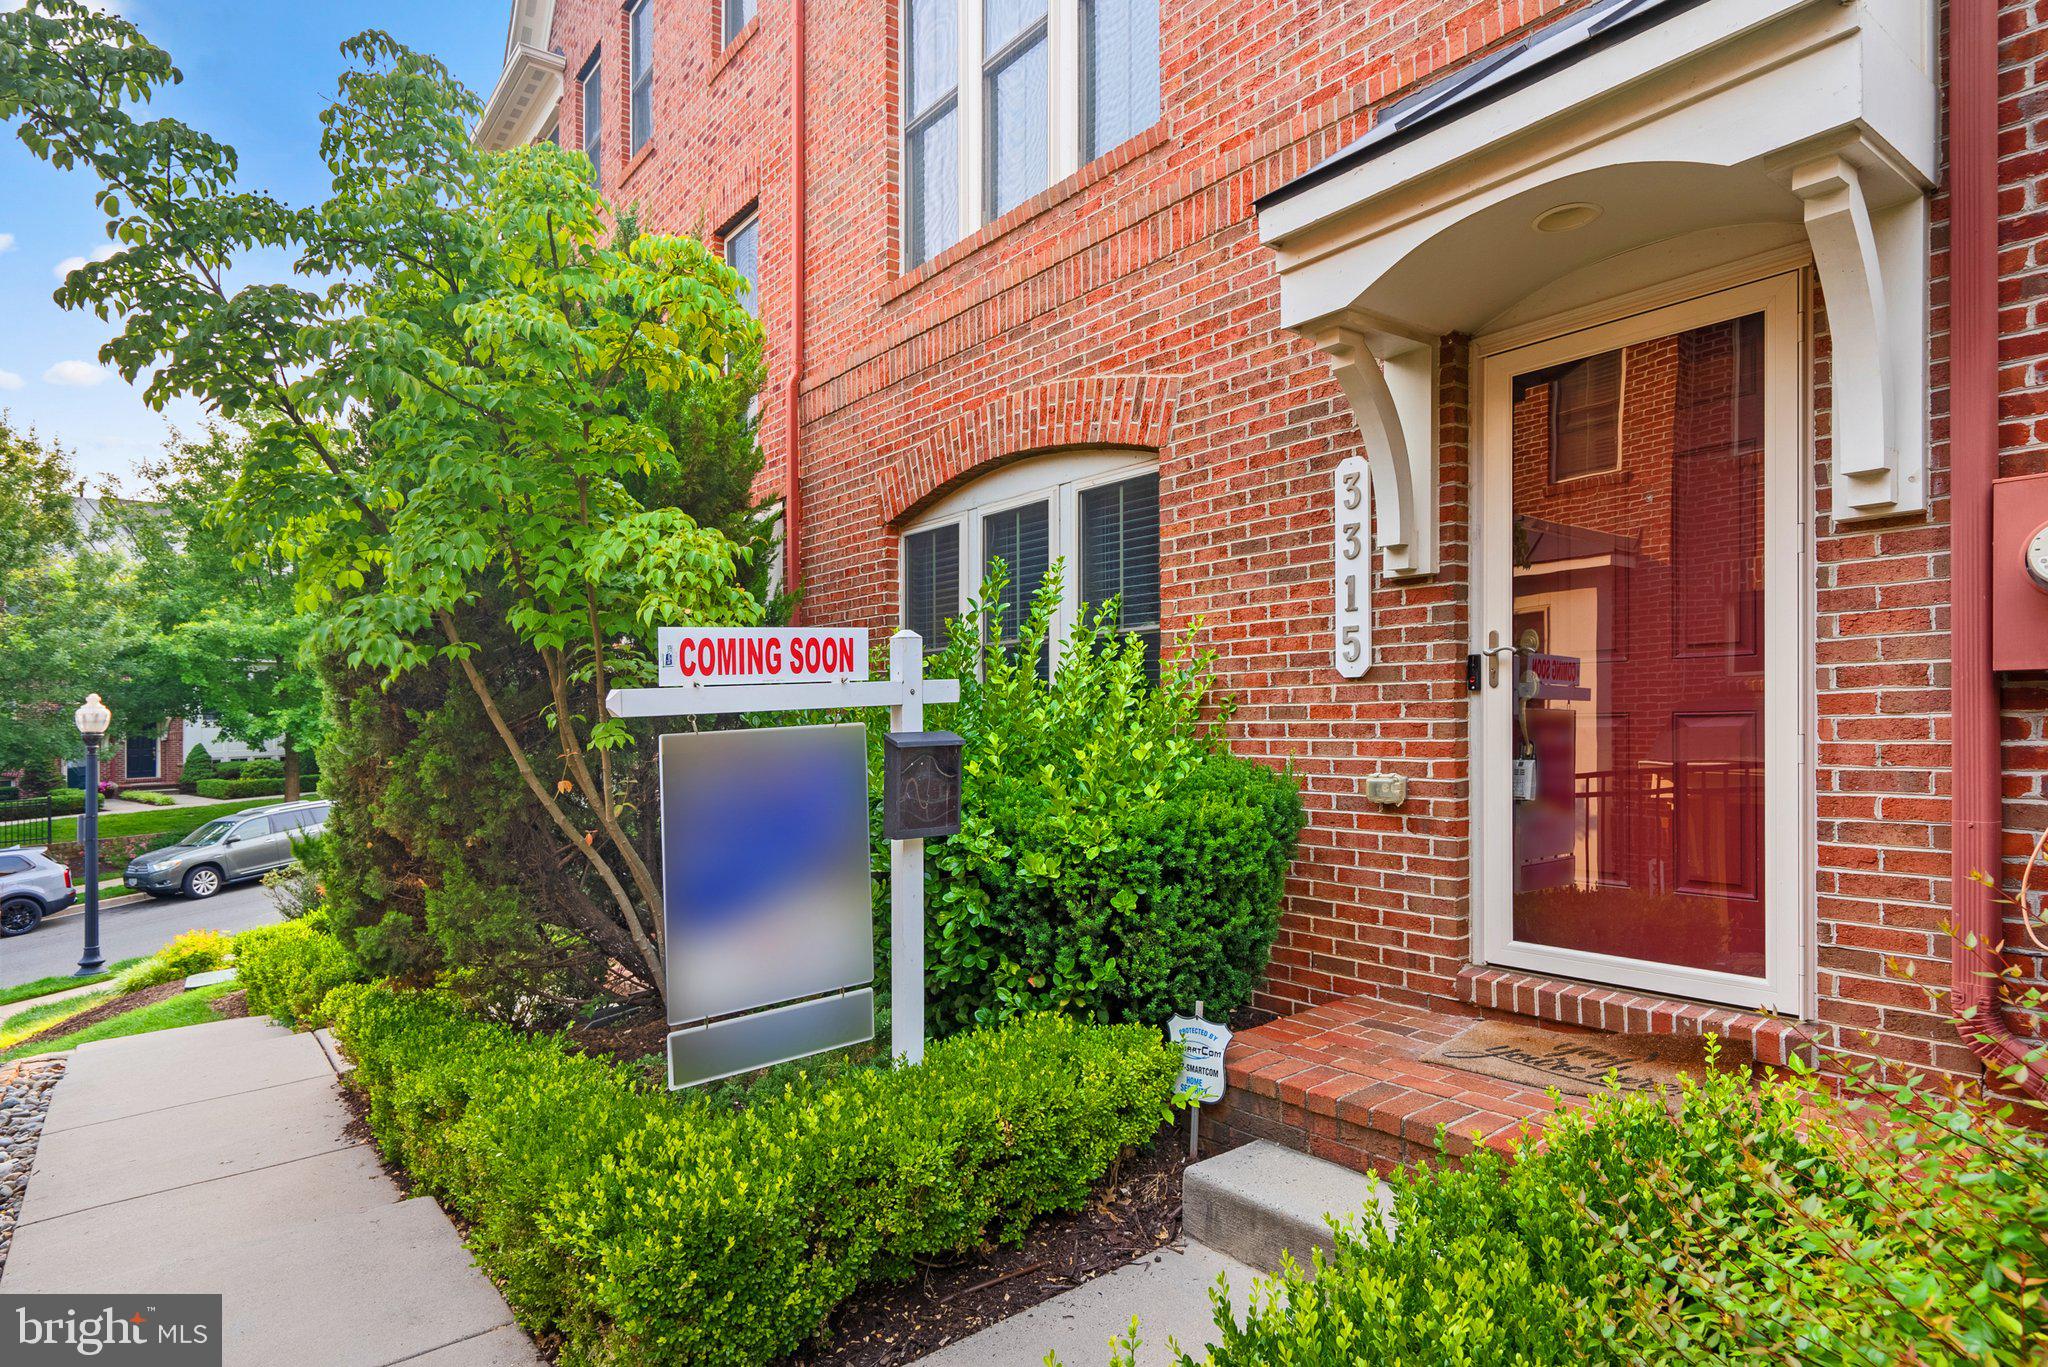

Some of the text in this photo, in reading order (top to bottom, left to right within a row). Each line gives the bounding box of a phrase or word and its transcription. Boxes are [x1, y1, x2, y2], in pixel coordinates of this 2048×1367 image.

[1342, 471, 1362, 663] 3315
[679, 637, 782, 677] COMING
[789, 637, 854, 674] SOON
[1179, 1027, 1218, 1041] PROTECTED BY
[1186, 1076, 1202, 1087] HOME
